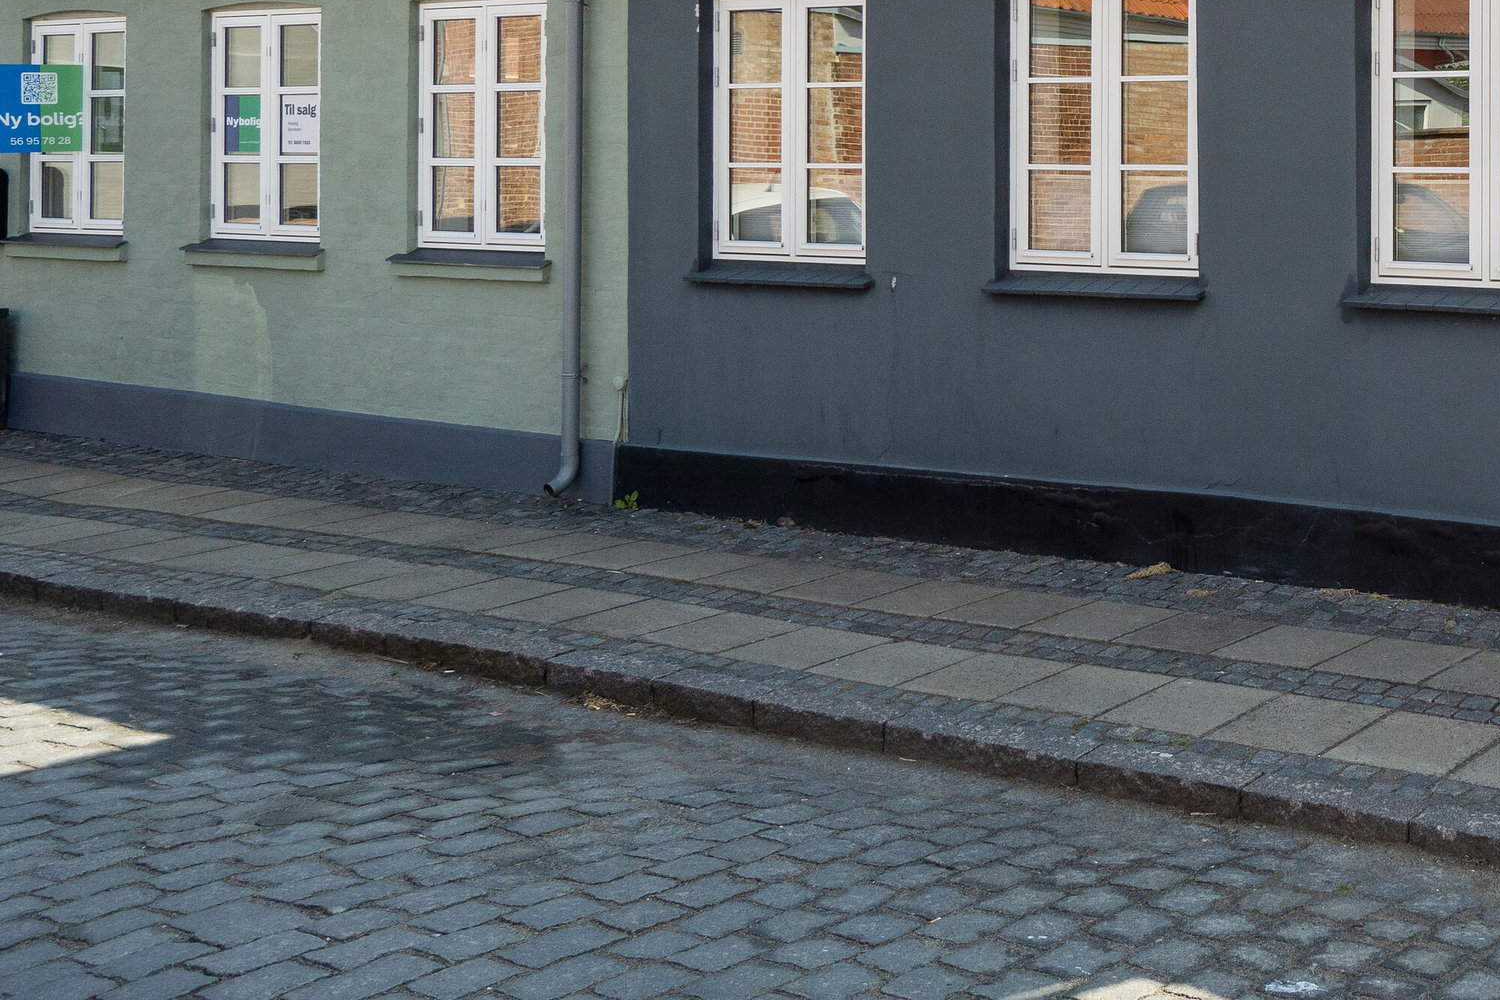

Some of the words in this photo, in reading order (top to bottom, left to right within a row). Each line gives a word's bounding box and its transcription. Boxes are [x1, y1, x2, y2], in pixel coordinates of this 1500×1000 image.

[284, 104, 295, 116] Til
[297, 104, 317, 118] salg
[226, 116, 261, 129] Nybolig
[10, 136, 24, 146] 56
[26, 136, 40, 146] 95
[42, 136, 56, 145] 78
[58, 136, 72, 145] 28
